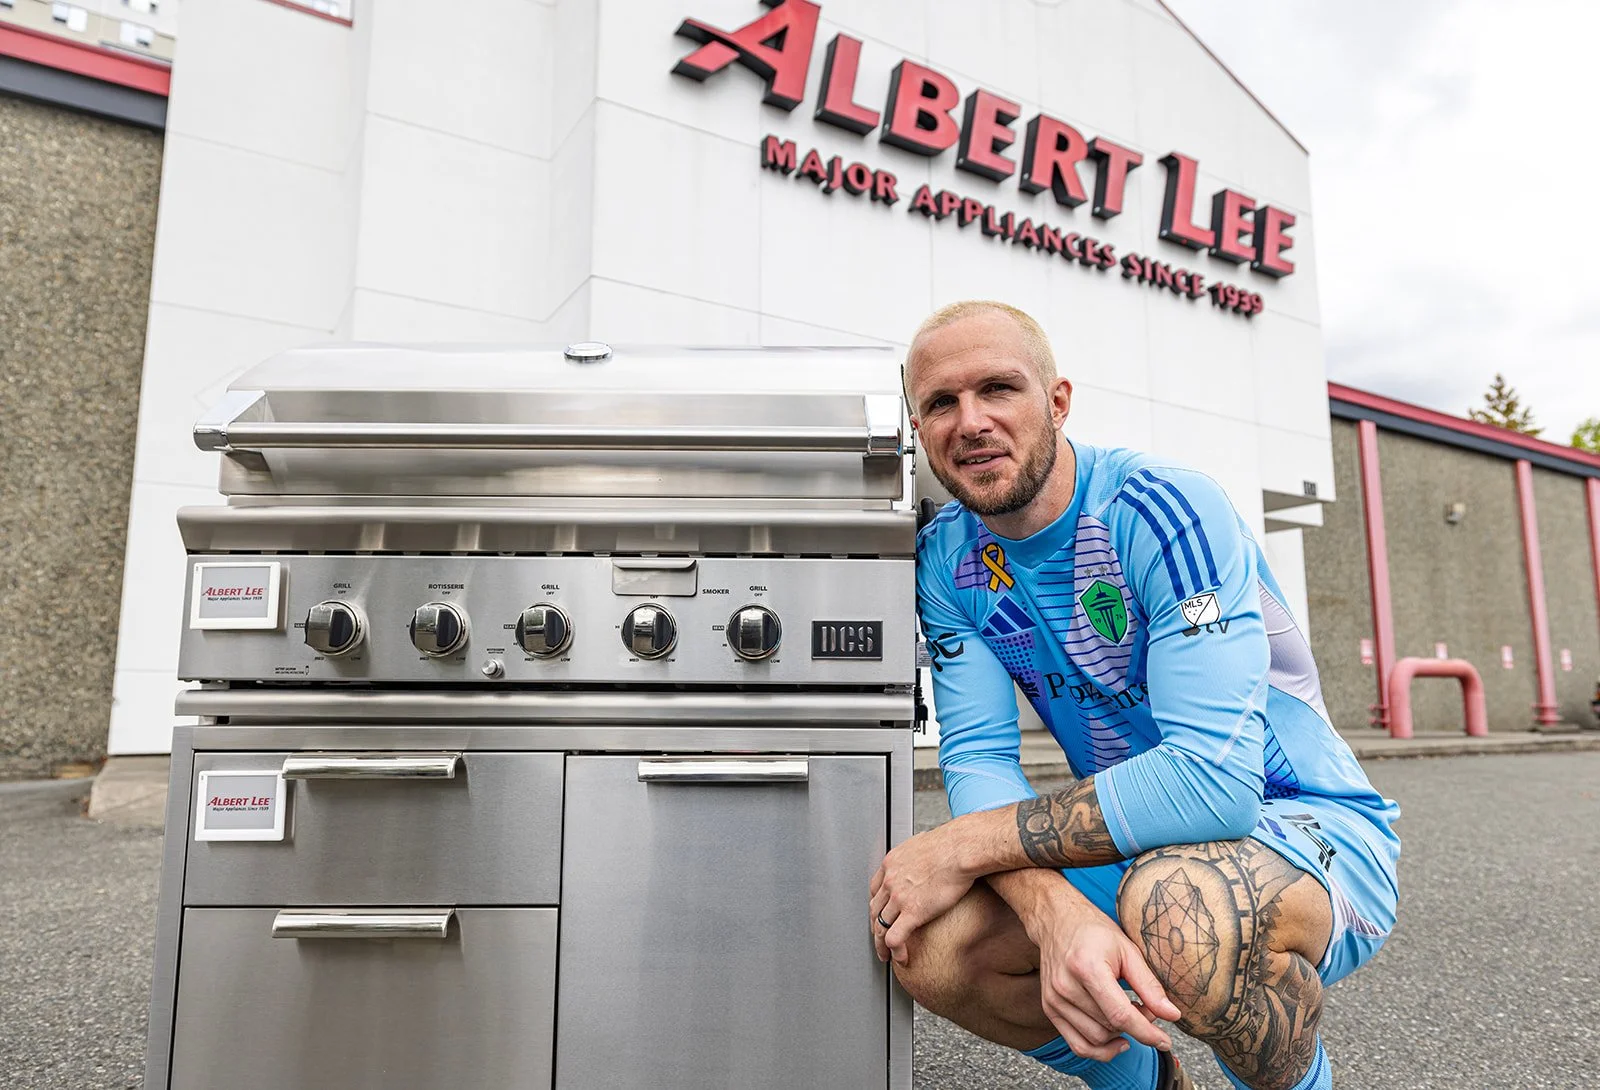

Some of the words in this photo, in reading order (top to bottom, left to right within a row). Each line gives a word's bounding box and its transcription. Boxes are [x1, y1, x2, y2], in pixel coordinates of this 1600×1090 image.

[670, 0, 1143, 220] ALBERT
[1158, 152, 1296, 278] LEE
[761, 134, 899, 207] MAJOR
[908, 184, 1117, 271] APPLIANCES
[1120, 252, 1206, 300] SINCE
[1207, 280, 1264, 318] 1939
[202, 587, 243, 596] ALBERT
[245, 587, 263, 596] LEE
[1184, 599, 1203, 609] MLS
[821, 626, 874, 652] DCS
[207, 796, 249, 806] ALBERT
[251, 796, 270, 806] LEE
